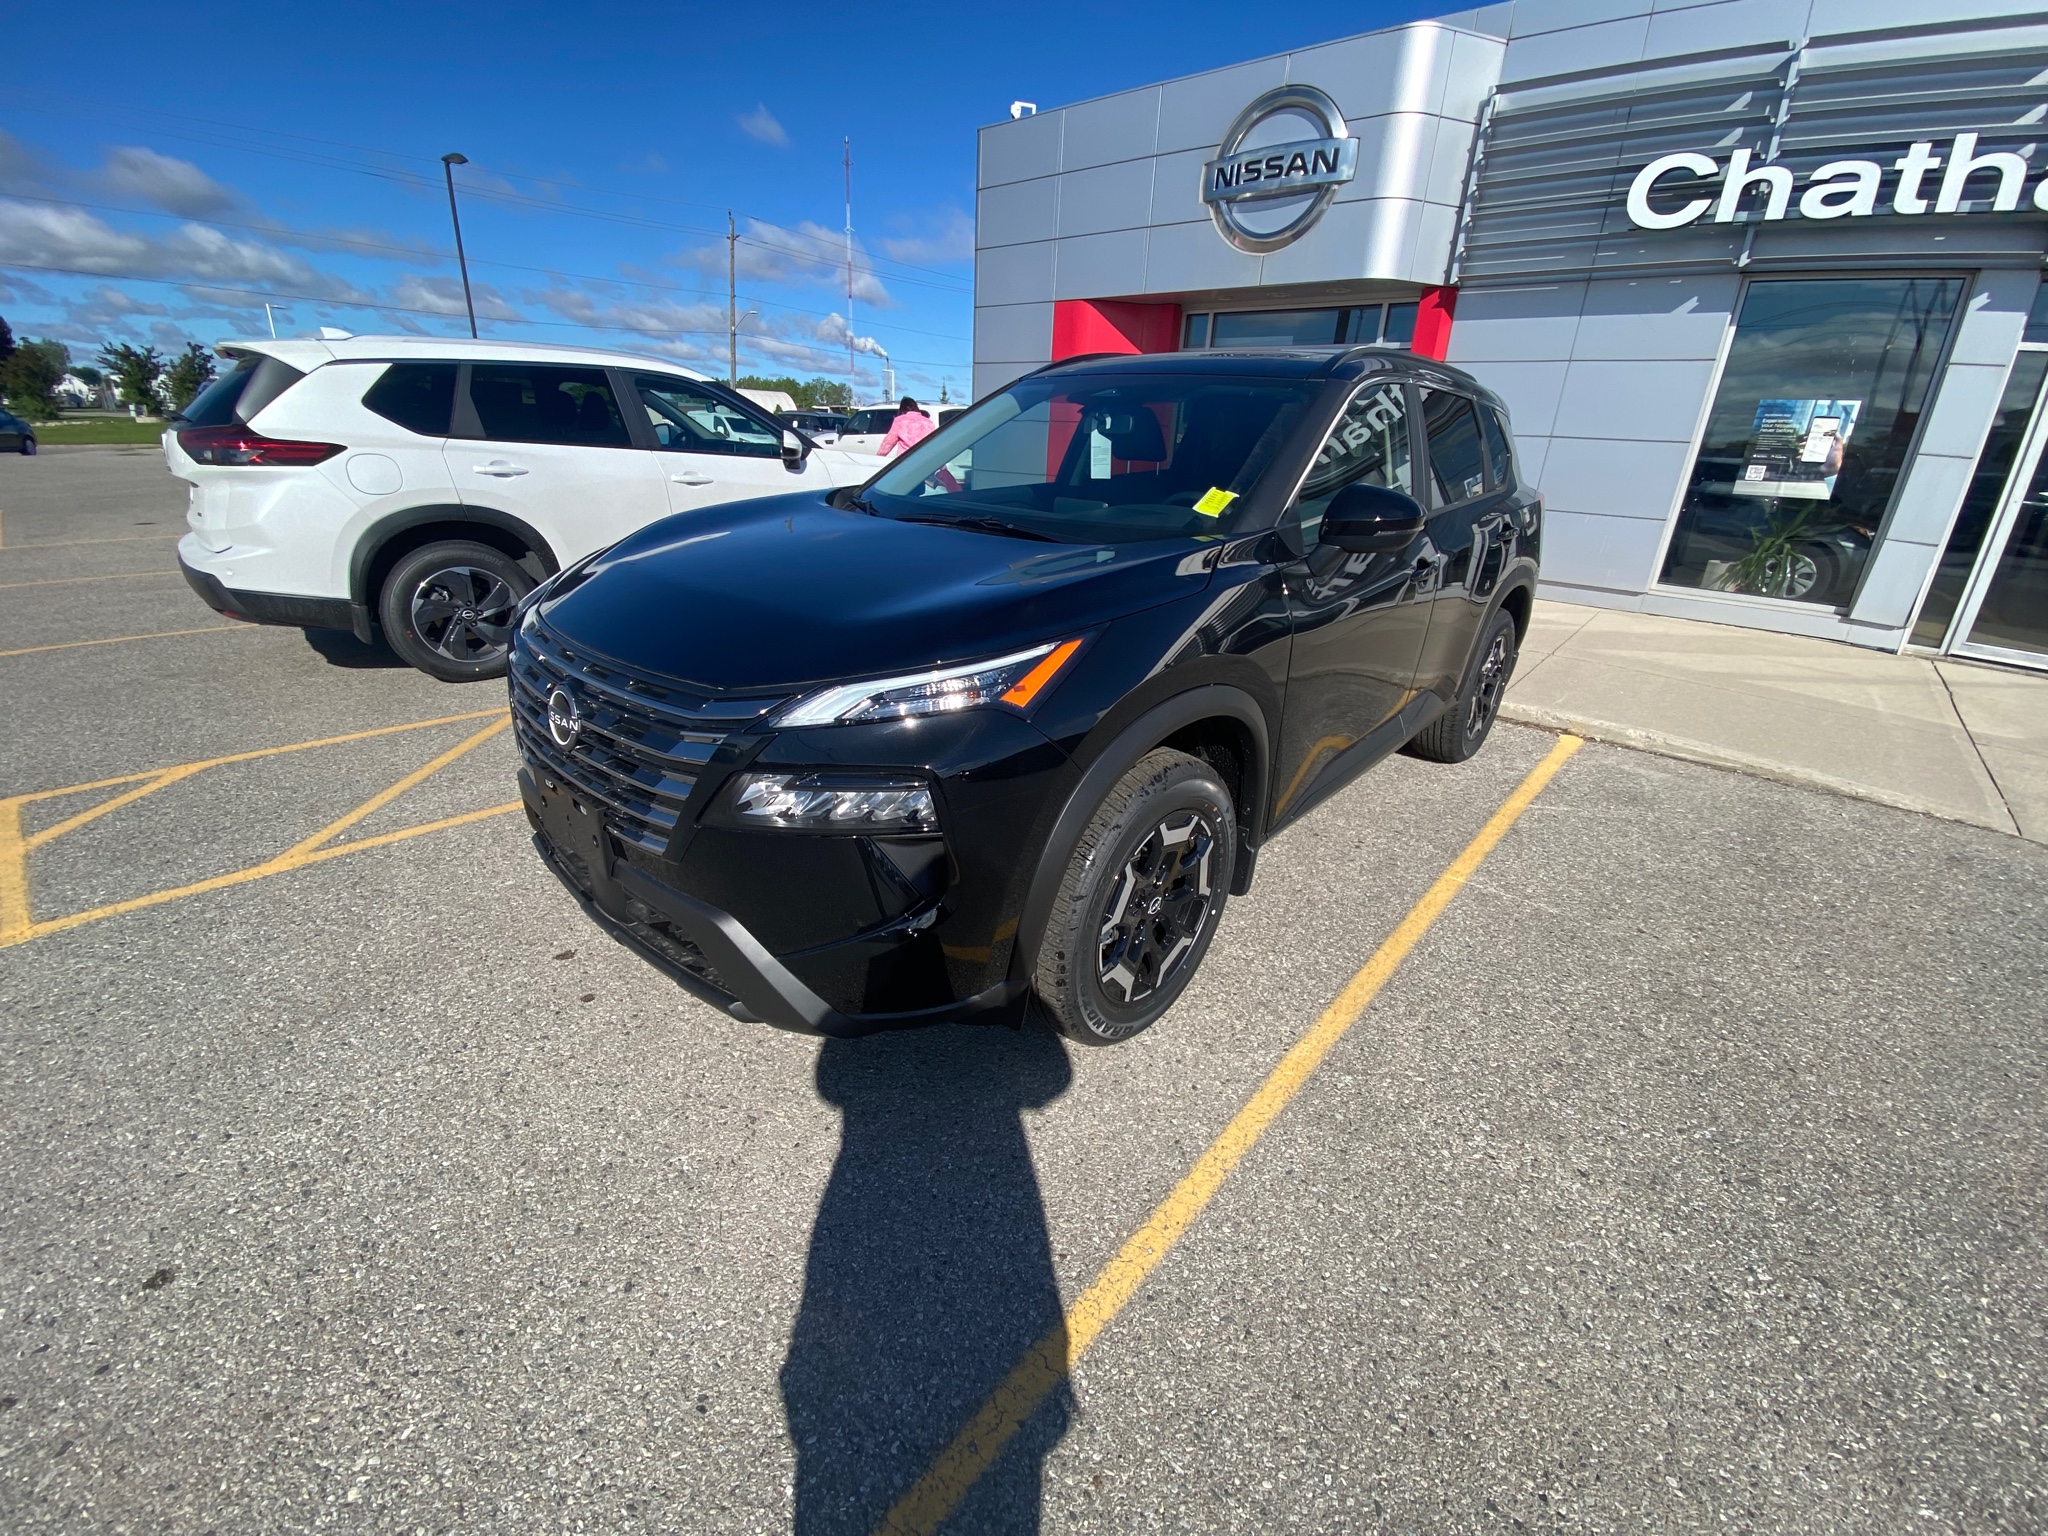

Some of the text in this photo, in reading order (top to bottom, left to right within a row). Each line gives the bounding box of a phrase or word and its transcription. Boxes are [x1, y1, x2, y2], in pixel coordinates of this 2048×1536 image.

[1213, 147, 1340, 191] NISSAN
[1626, 132, 2048, 230] Chath
[549, 711, 579, 731] SSAN
